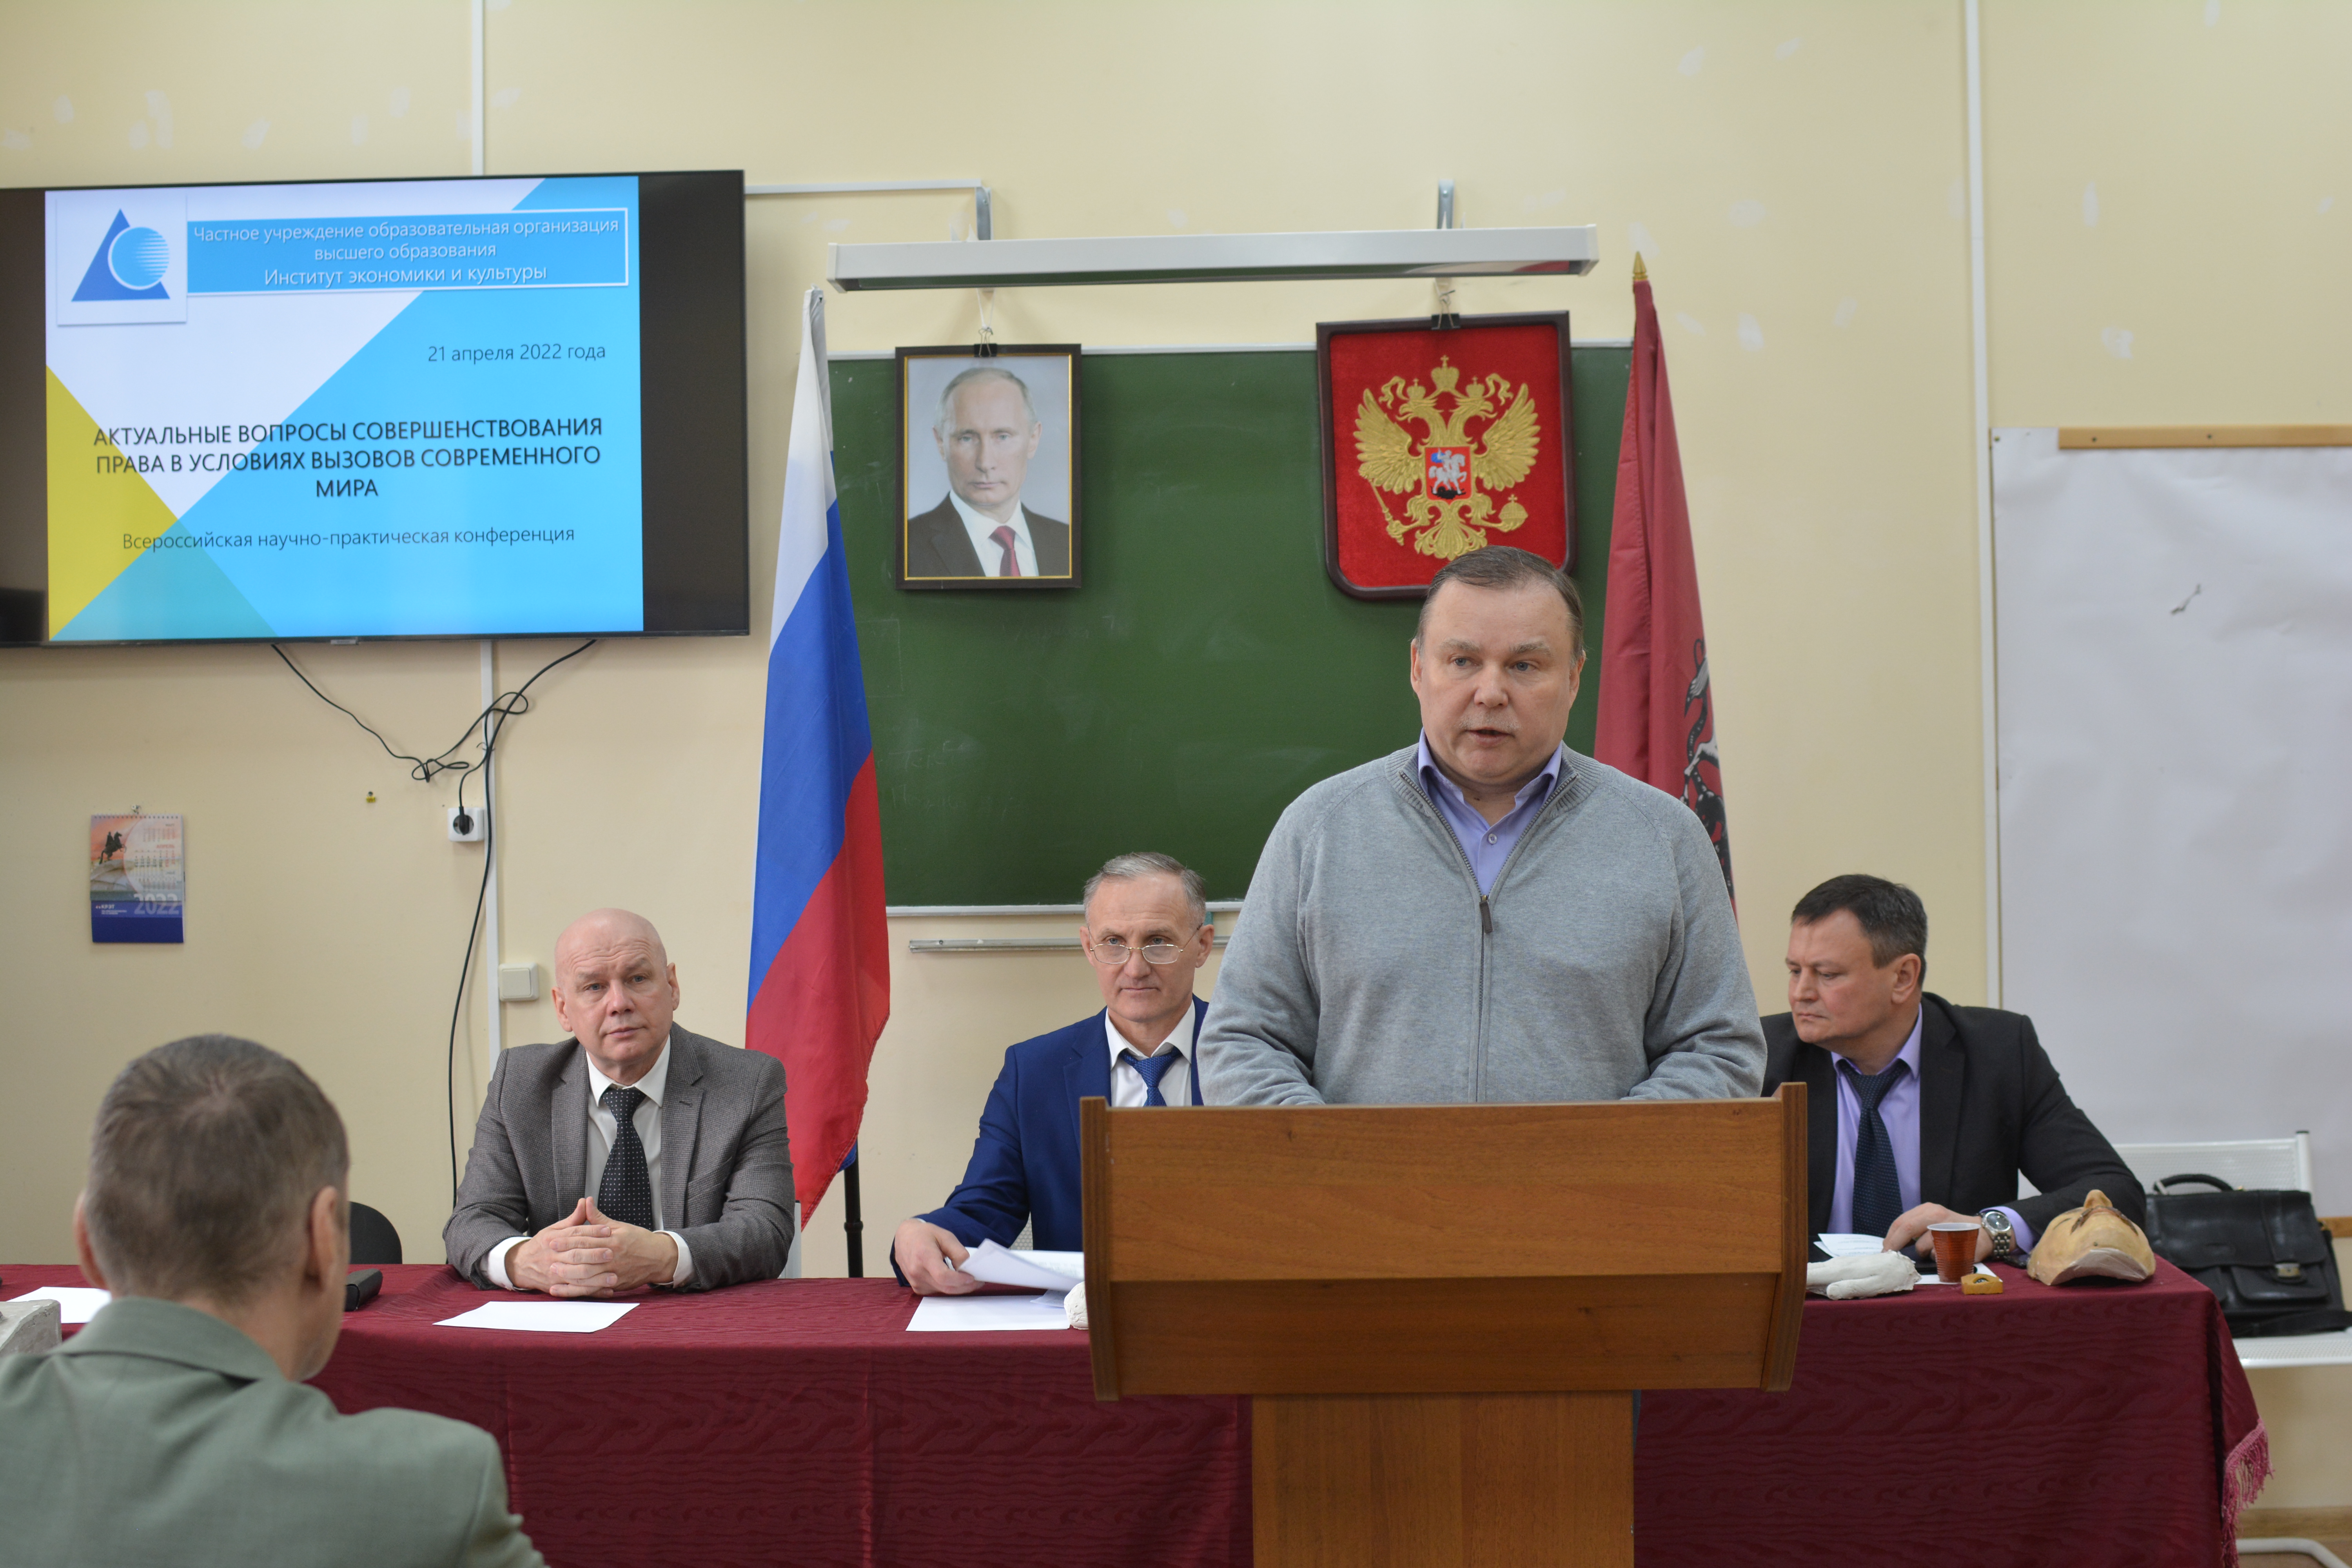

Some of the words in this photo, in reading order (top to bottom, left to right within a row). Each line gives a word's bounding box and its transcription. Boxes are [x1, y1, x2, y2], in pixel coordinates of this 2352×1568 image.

[194, 227, 259, 241] Частное
[264, 225, 364, 243] учреждение
[368, 221, 509, 240] образовательная
[514, 220, 619, 237] организация
[315, 248, 384, 260] высшего
[389, 243, 496, 261] образования
[265, 269, 343, 288] Институт
[349, 269, 445, 283] экономики
[452, 269, 462, 280] и
[468, 267, 546, 285] культуры
[428, 346, 445, 361] 21
[452, 348, 514, 365] апреля
[520, 343, 561, 359] 2022
[568, 346, 606, 361] года
[94, 426, 231, 445] АКТУАЛЬНЫЕ
[239, 423, 345, 443] ВОПРОСЫ
[353, 418, 602, 440] СОВЕРШЕНСТВОВАНИЯ
[97, 454, 165, 473] ПРАВА
[171, 454, 182, 472] В
[189, 452, 305, 472] УСЛОВИЯХ
[312, 450, 415, 469] ВЫЗОВОВ
[421, 446, 601, 467] СОВРЕМЕННОГО
[316, 479, 379, 497] МИРА
[123, 532, 252, 553] Всероссийская
[258, 532, 449, 550] научно-практическая
[455, 527, 574, 546] конференция
[133, 893, 180, 915] 2022
